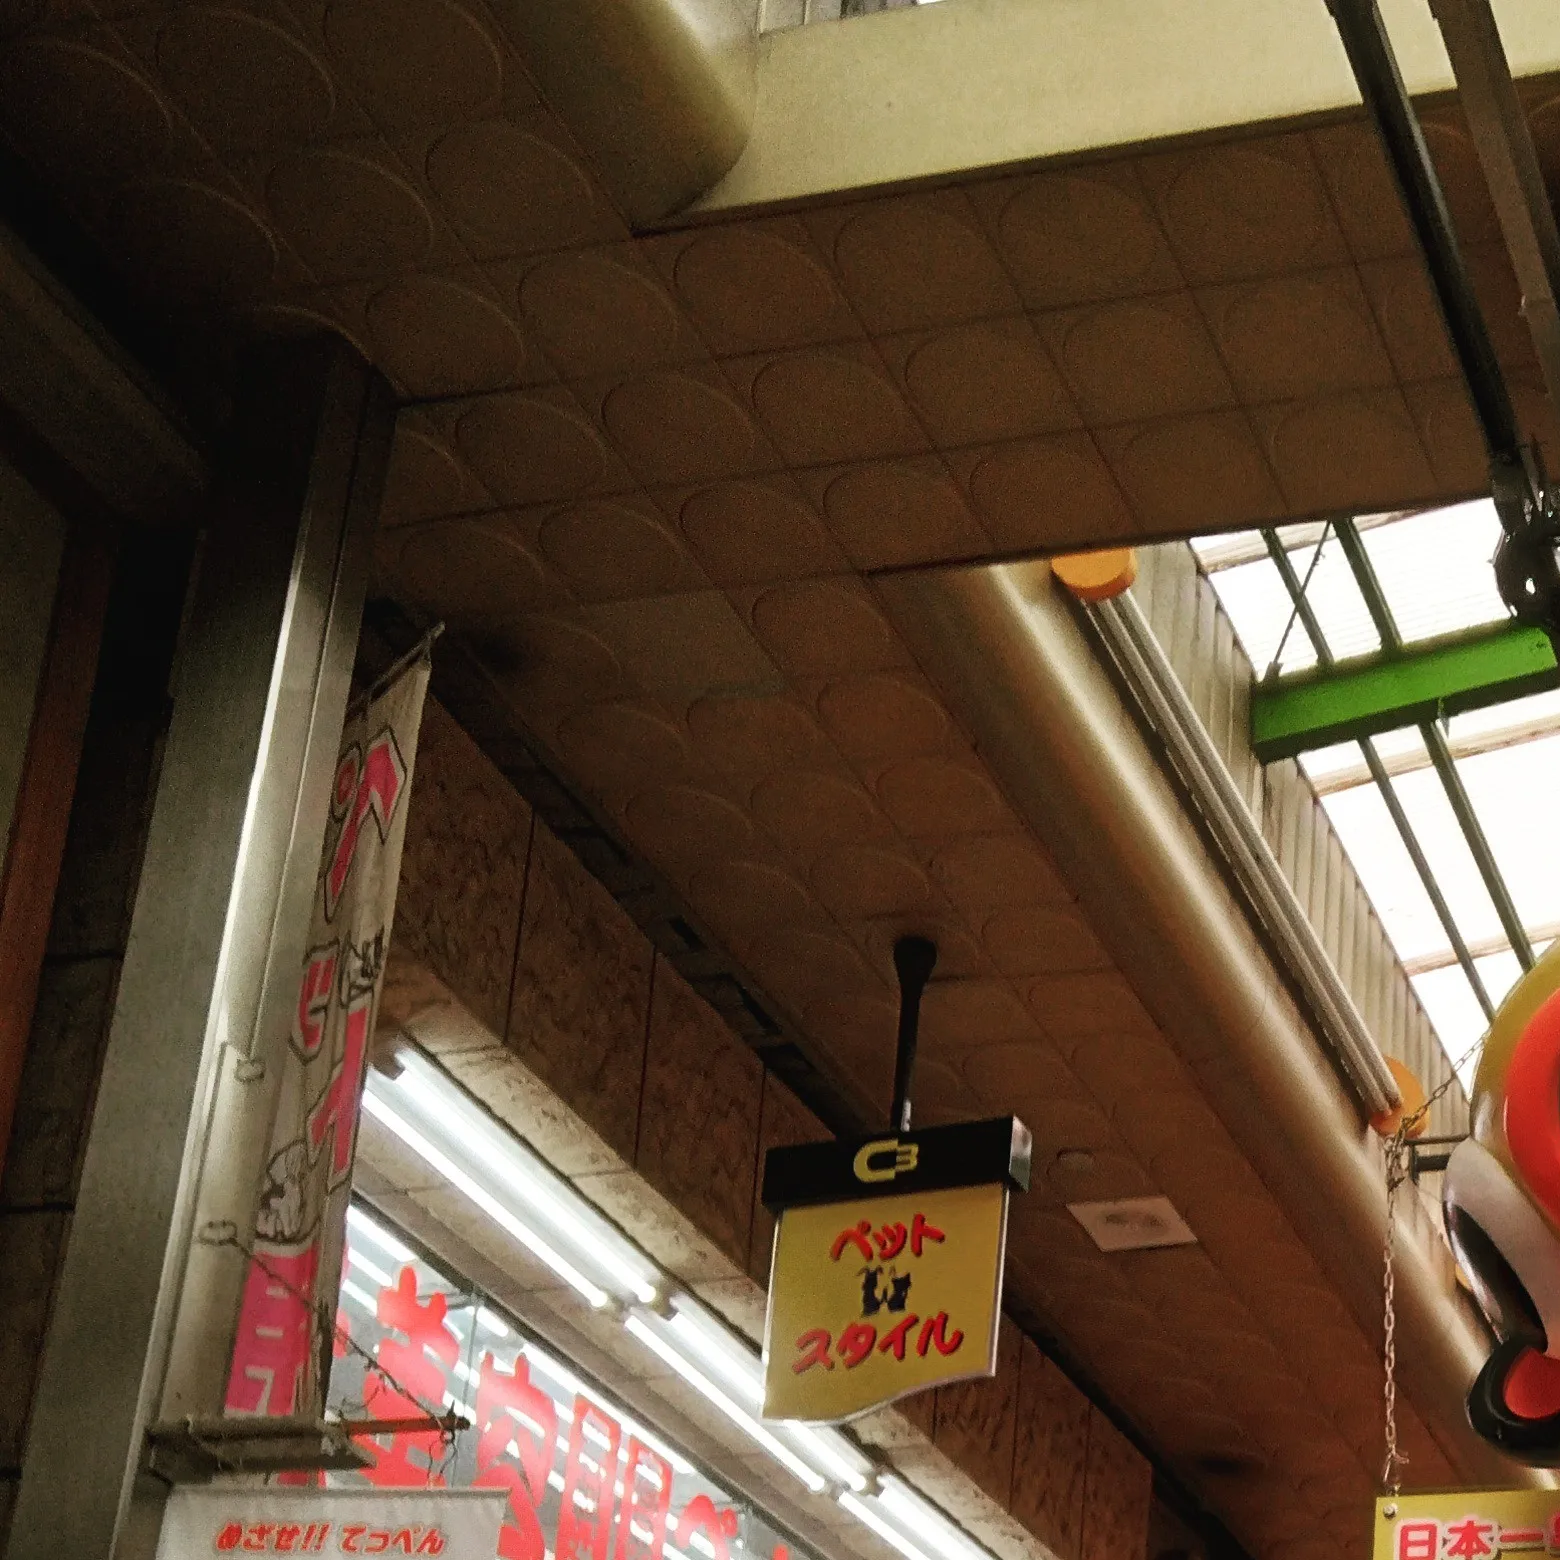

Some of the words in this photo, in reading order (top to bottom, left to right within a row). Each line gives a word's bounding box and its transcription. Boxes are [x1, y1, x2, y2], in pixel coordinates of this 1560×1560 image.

[832, 1213, 947, 1263] ペット
[793, 1312, 965, 1374] スタイル
[341, 1525, 446, 1557] てっぺん
